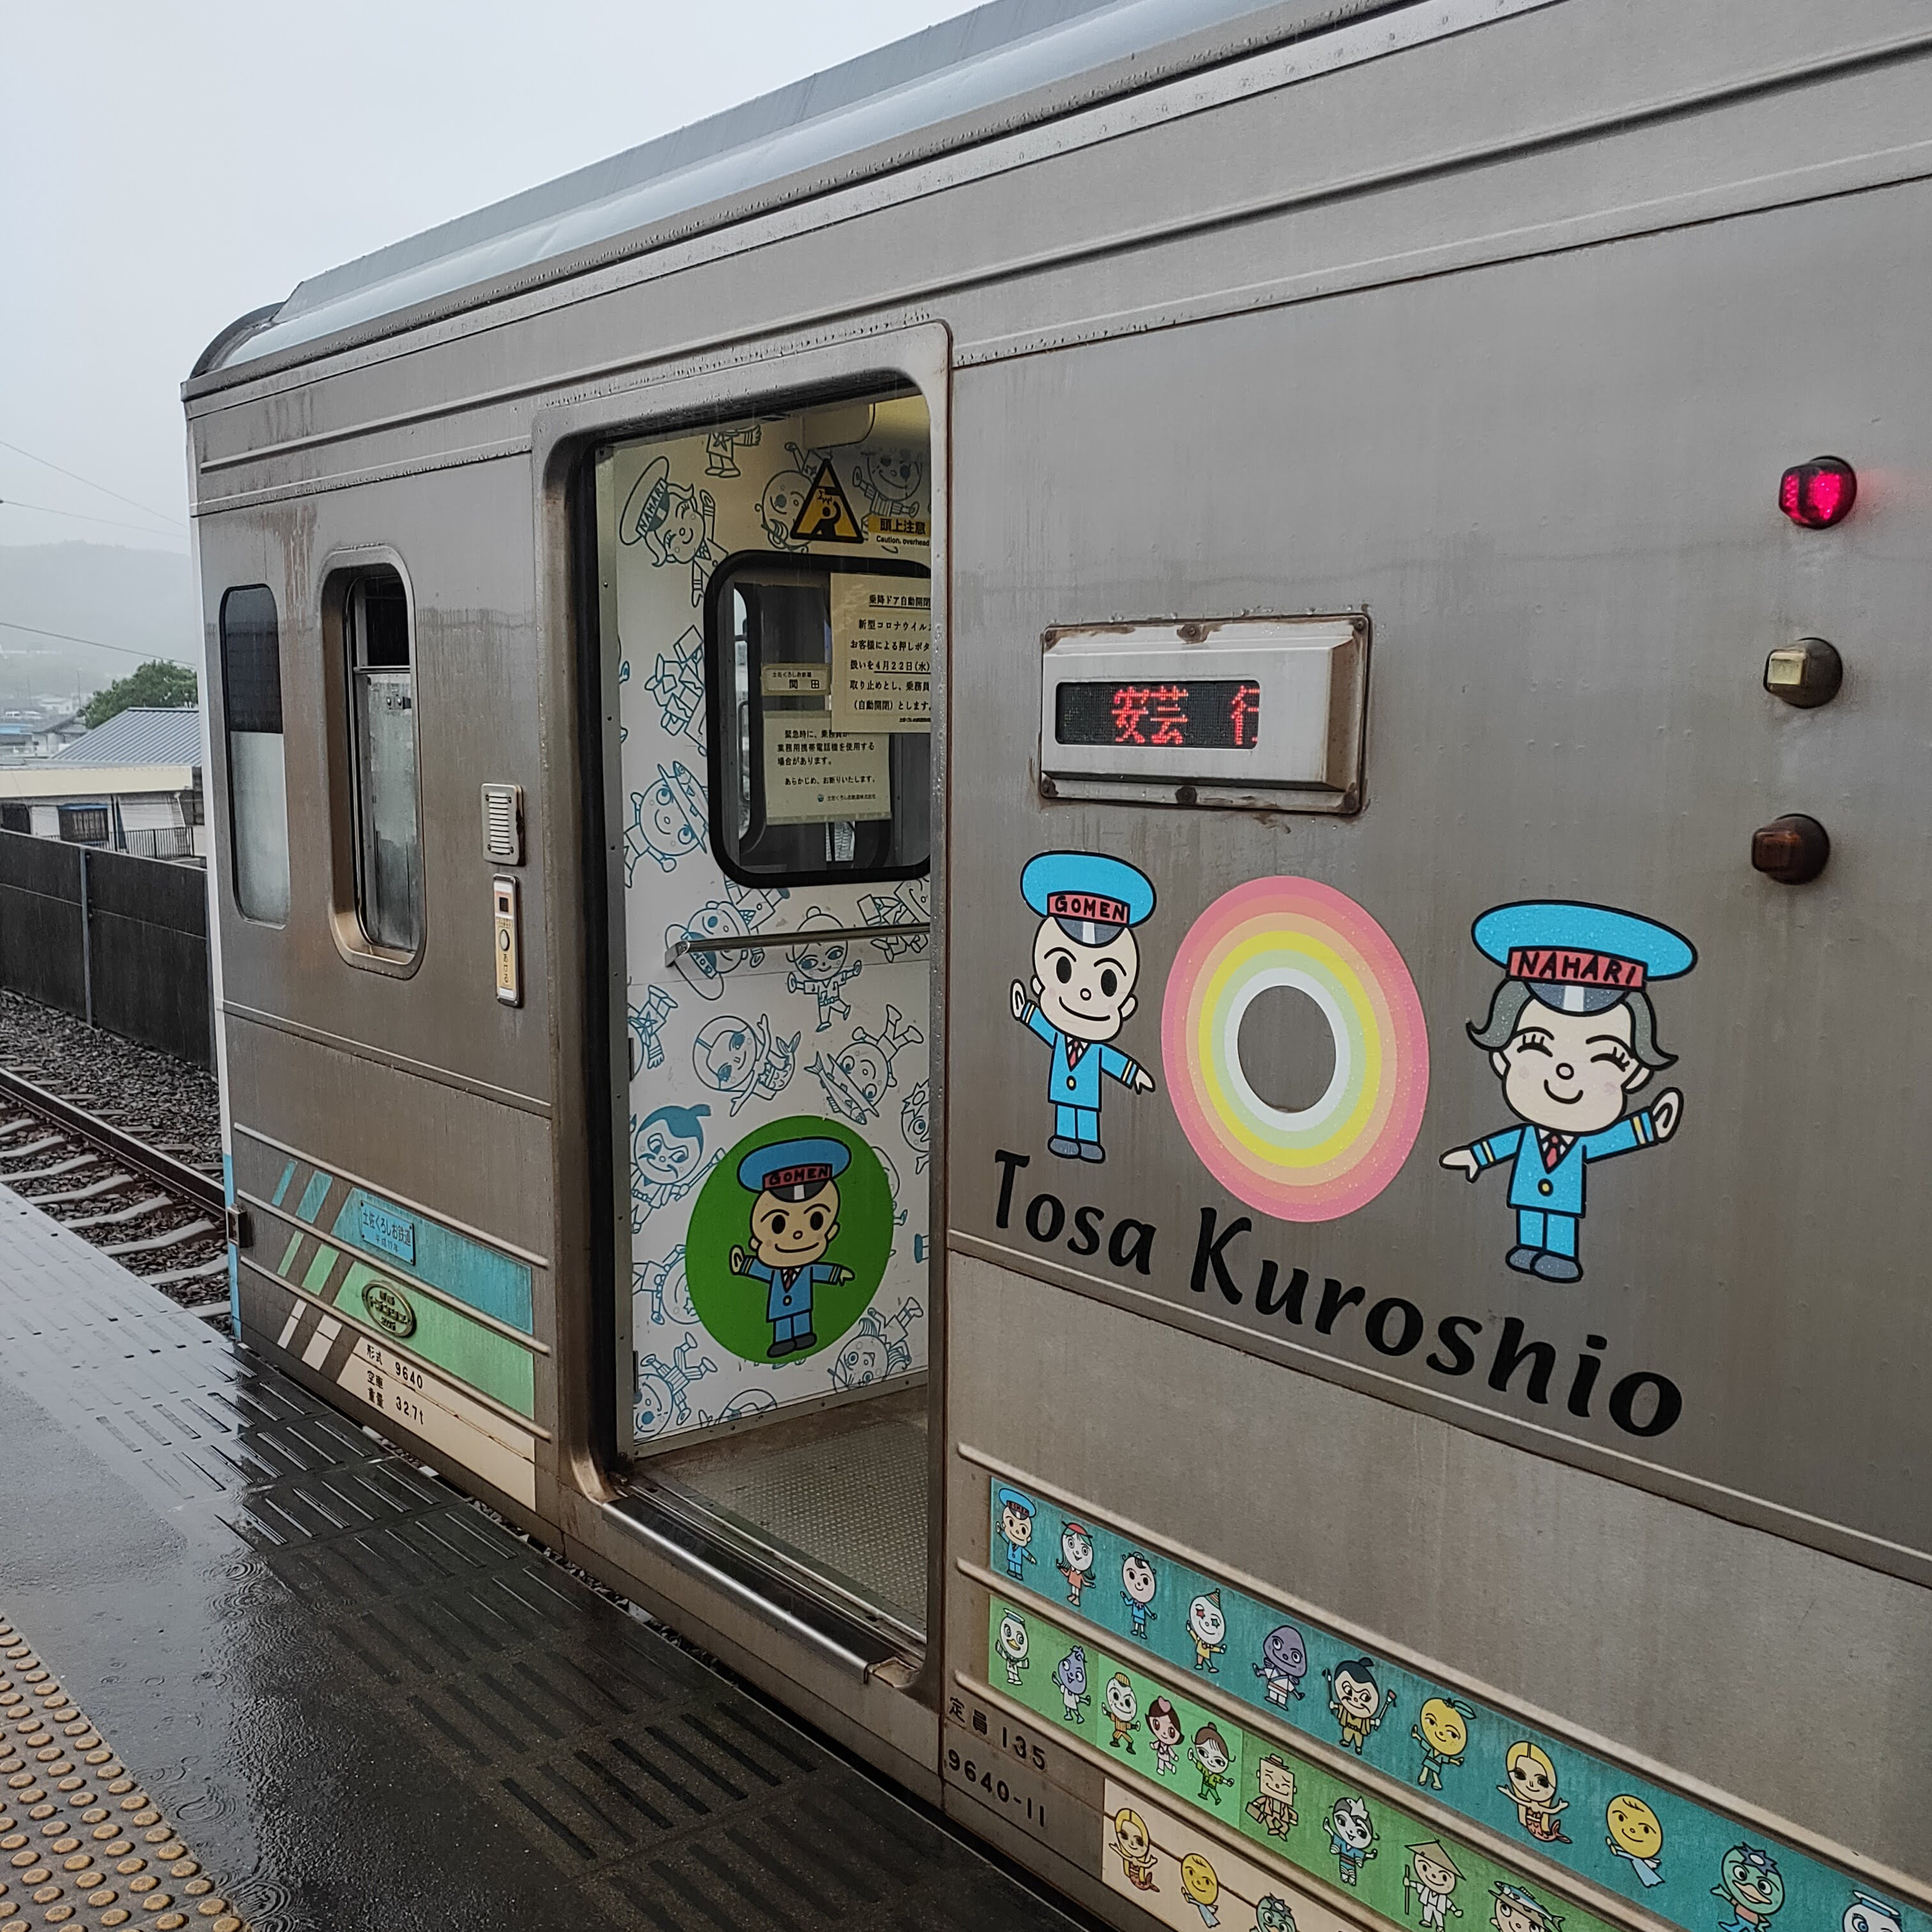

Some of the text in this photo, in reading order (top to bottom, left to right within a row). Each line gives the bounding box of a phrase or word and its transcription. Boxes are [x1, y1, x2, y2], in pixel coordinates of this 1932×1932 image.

[638, 482, 665, 533] NAHARI
[880, 518, 926, 535] 頭上注意
[902, 538, 930, 547] overhead
[1112, 685, 1189, 745] 安芸
[1054, 895, 1126, 922] GOMEN
[1516, 950, 1636, 985] NAHARI
[769, 1165, 829, 1186] GOMEN
[363, 1209, 412, 1247] 土佐くろしお鉄道
[994, 1149, 1683, 1437] Tosa Kuroshio
[367, 1344, 423, 1389] 形式 9640
[367, 1370, 384, 1390] 空車
[368, 1387, 424, 1425] 重量 32.7t
[949, 1696, 1046, 1771] 定員 135
[947, 1748, 1045, 1828] 9640-11
